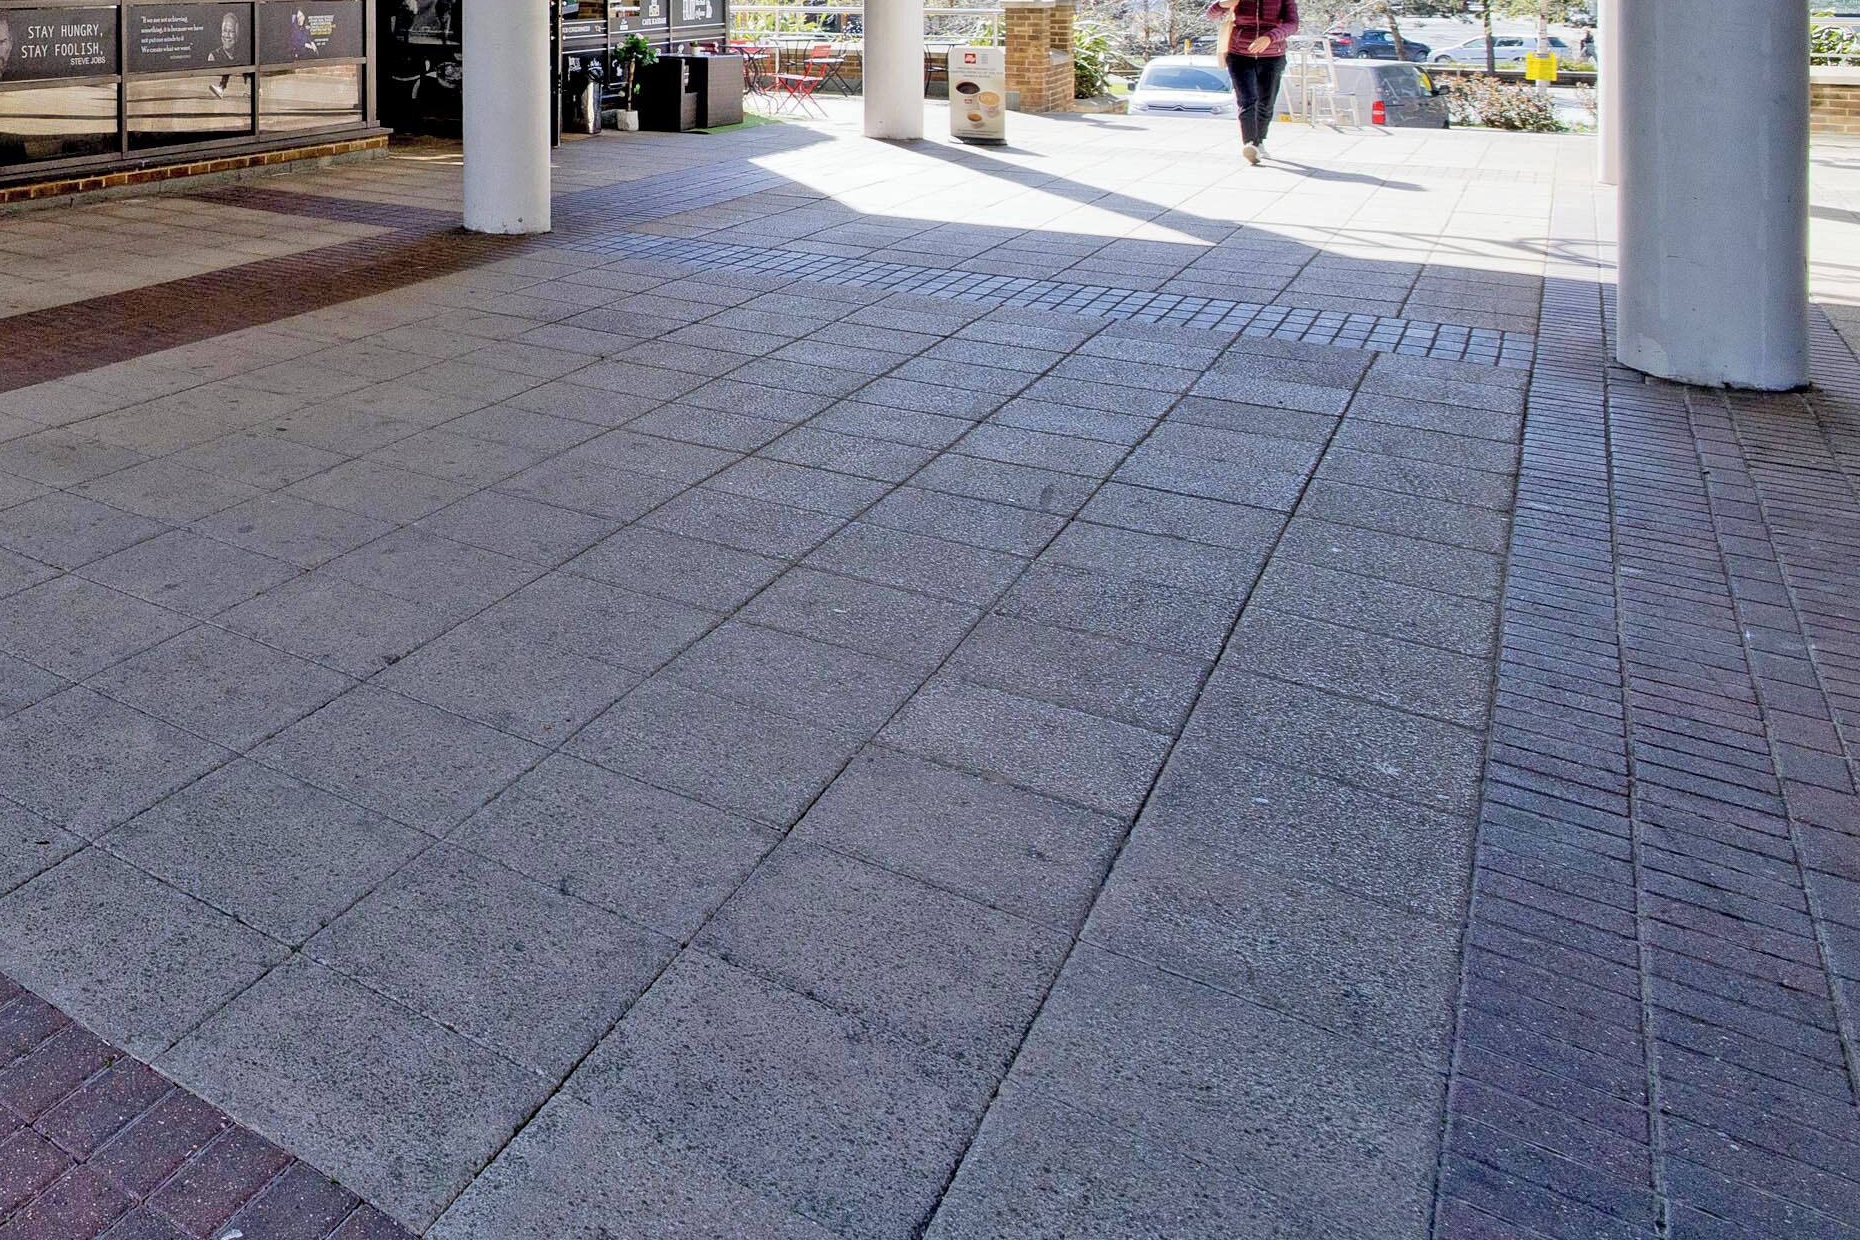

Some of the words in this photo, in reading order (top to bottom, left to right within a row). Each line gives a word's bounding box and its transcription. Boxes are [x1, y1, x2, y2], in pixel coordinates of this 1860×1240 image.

[28, 25, 54, 39] STAY
[61, 23, 103, 38] HUNGRY,
[21, 45, 48, 58] STAY
[91, 56, 106, 64] JOBS
